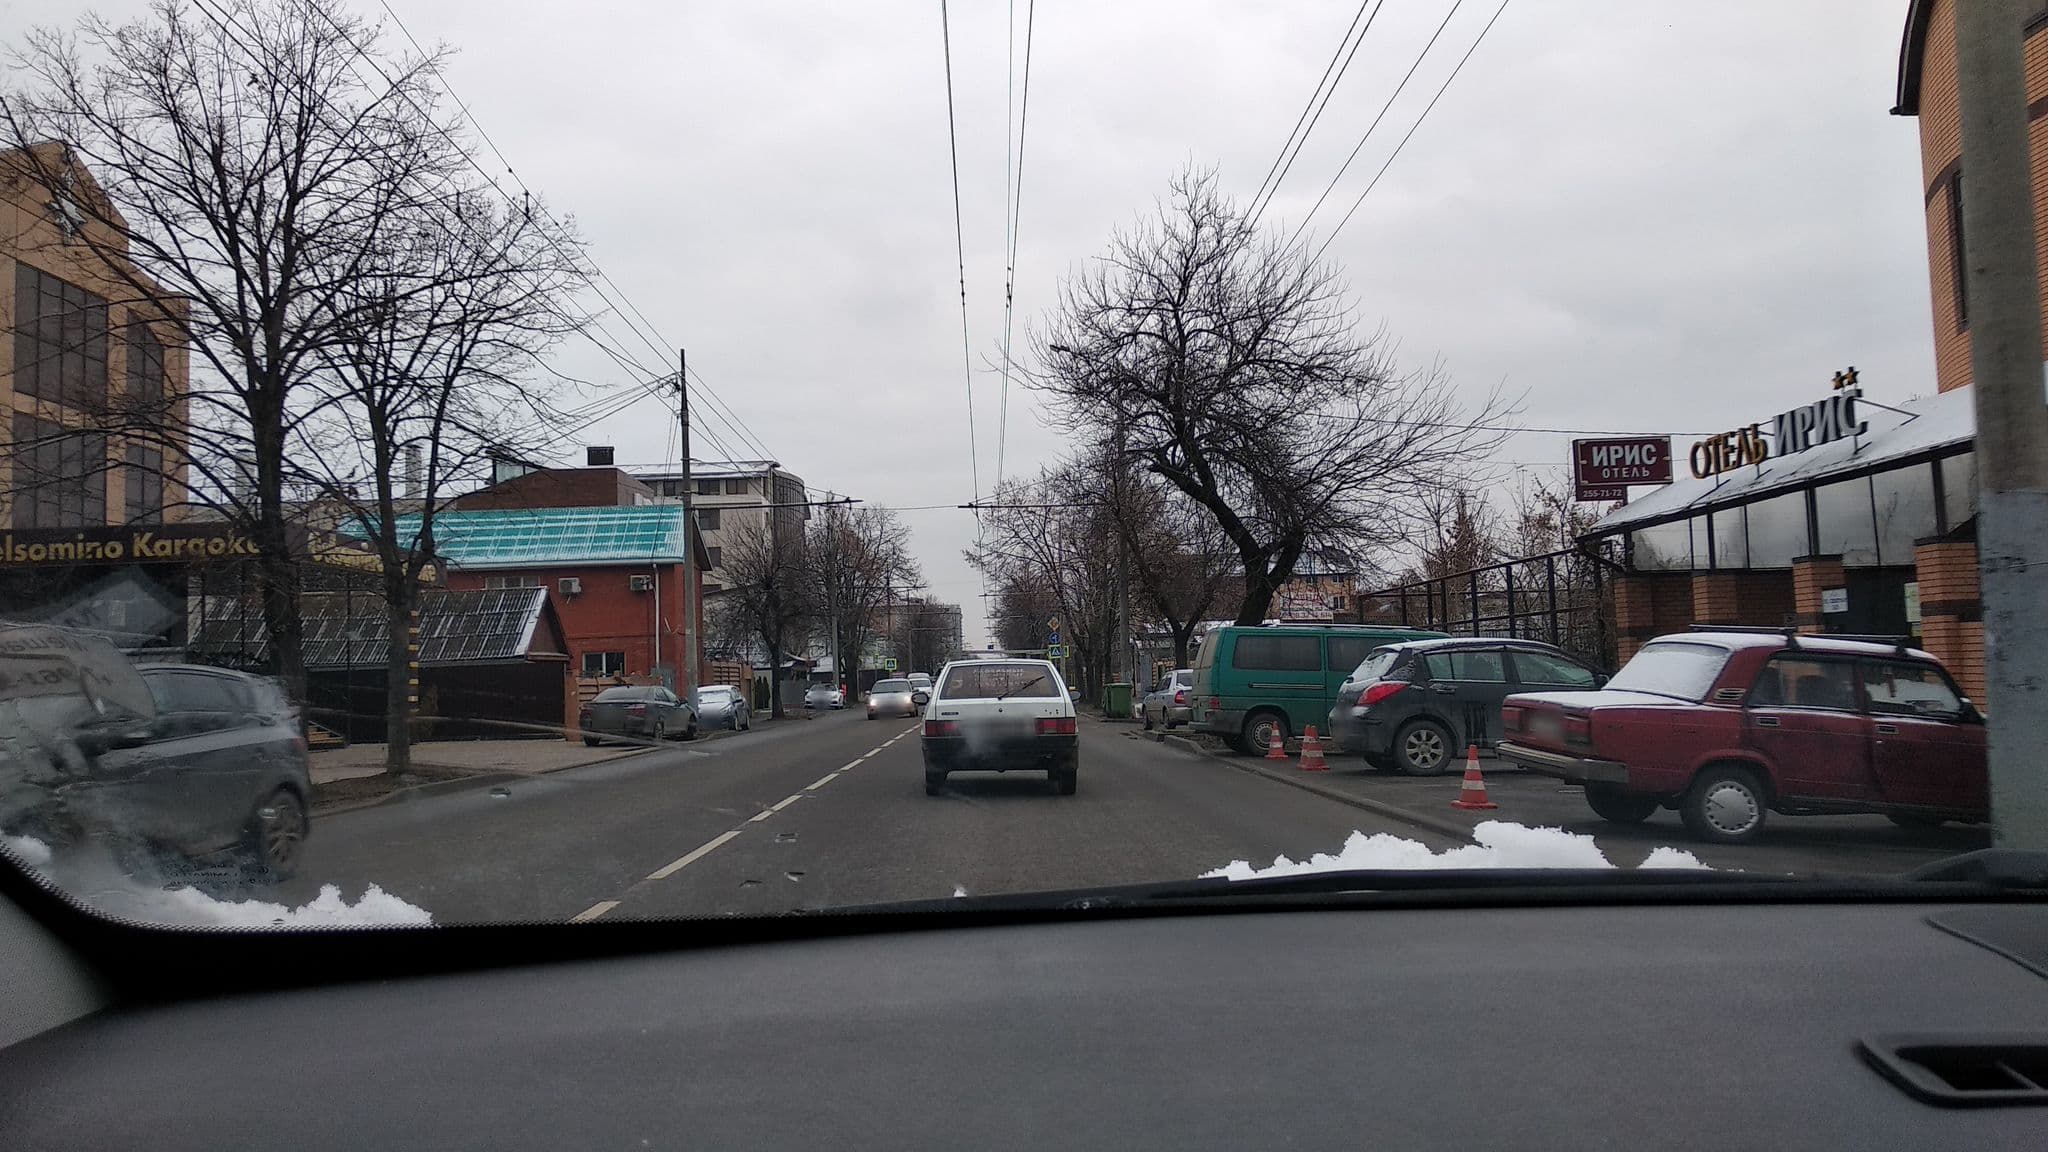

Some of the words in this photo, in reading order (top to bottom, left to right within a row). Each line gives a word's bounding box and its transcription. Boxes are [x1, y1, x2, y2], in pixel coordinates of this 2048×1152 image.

[1690, 424, 1768, 479] ОТЕЛЬ
[1773, 389, 1869, 457] ИРИС
[1592, 443, 1657, 467] ИРИС
[1602, 466, 1650, 479] ОТЕЛЬ
[1583, 489, 1623, 498] 255-71-72
[0, 533, 123, 562] lsomino
